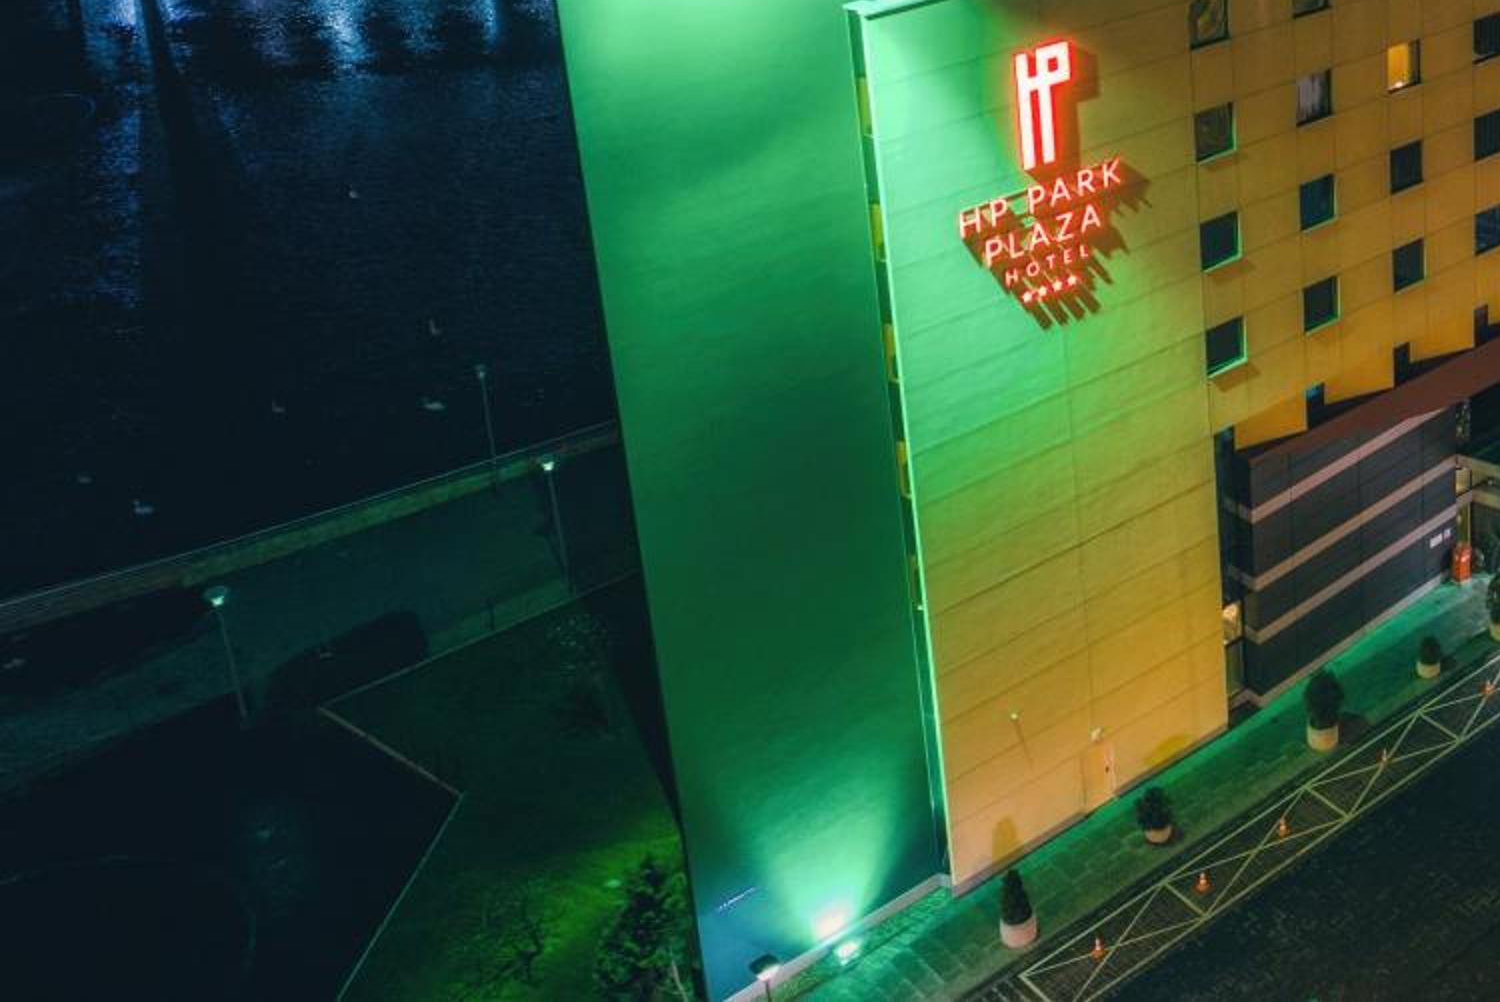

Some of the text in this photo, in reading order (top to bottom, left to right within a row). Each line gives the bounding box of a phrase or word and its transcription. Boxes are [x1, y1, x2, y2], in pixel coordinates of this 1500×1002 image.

[959, 157, 1121, 239] HP PARK
[984, 204, 1101, 268] PLAZA
[1004, 244, 1089, 287] HOTEL
